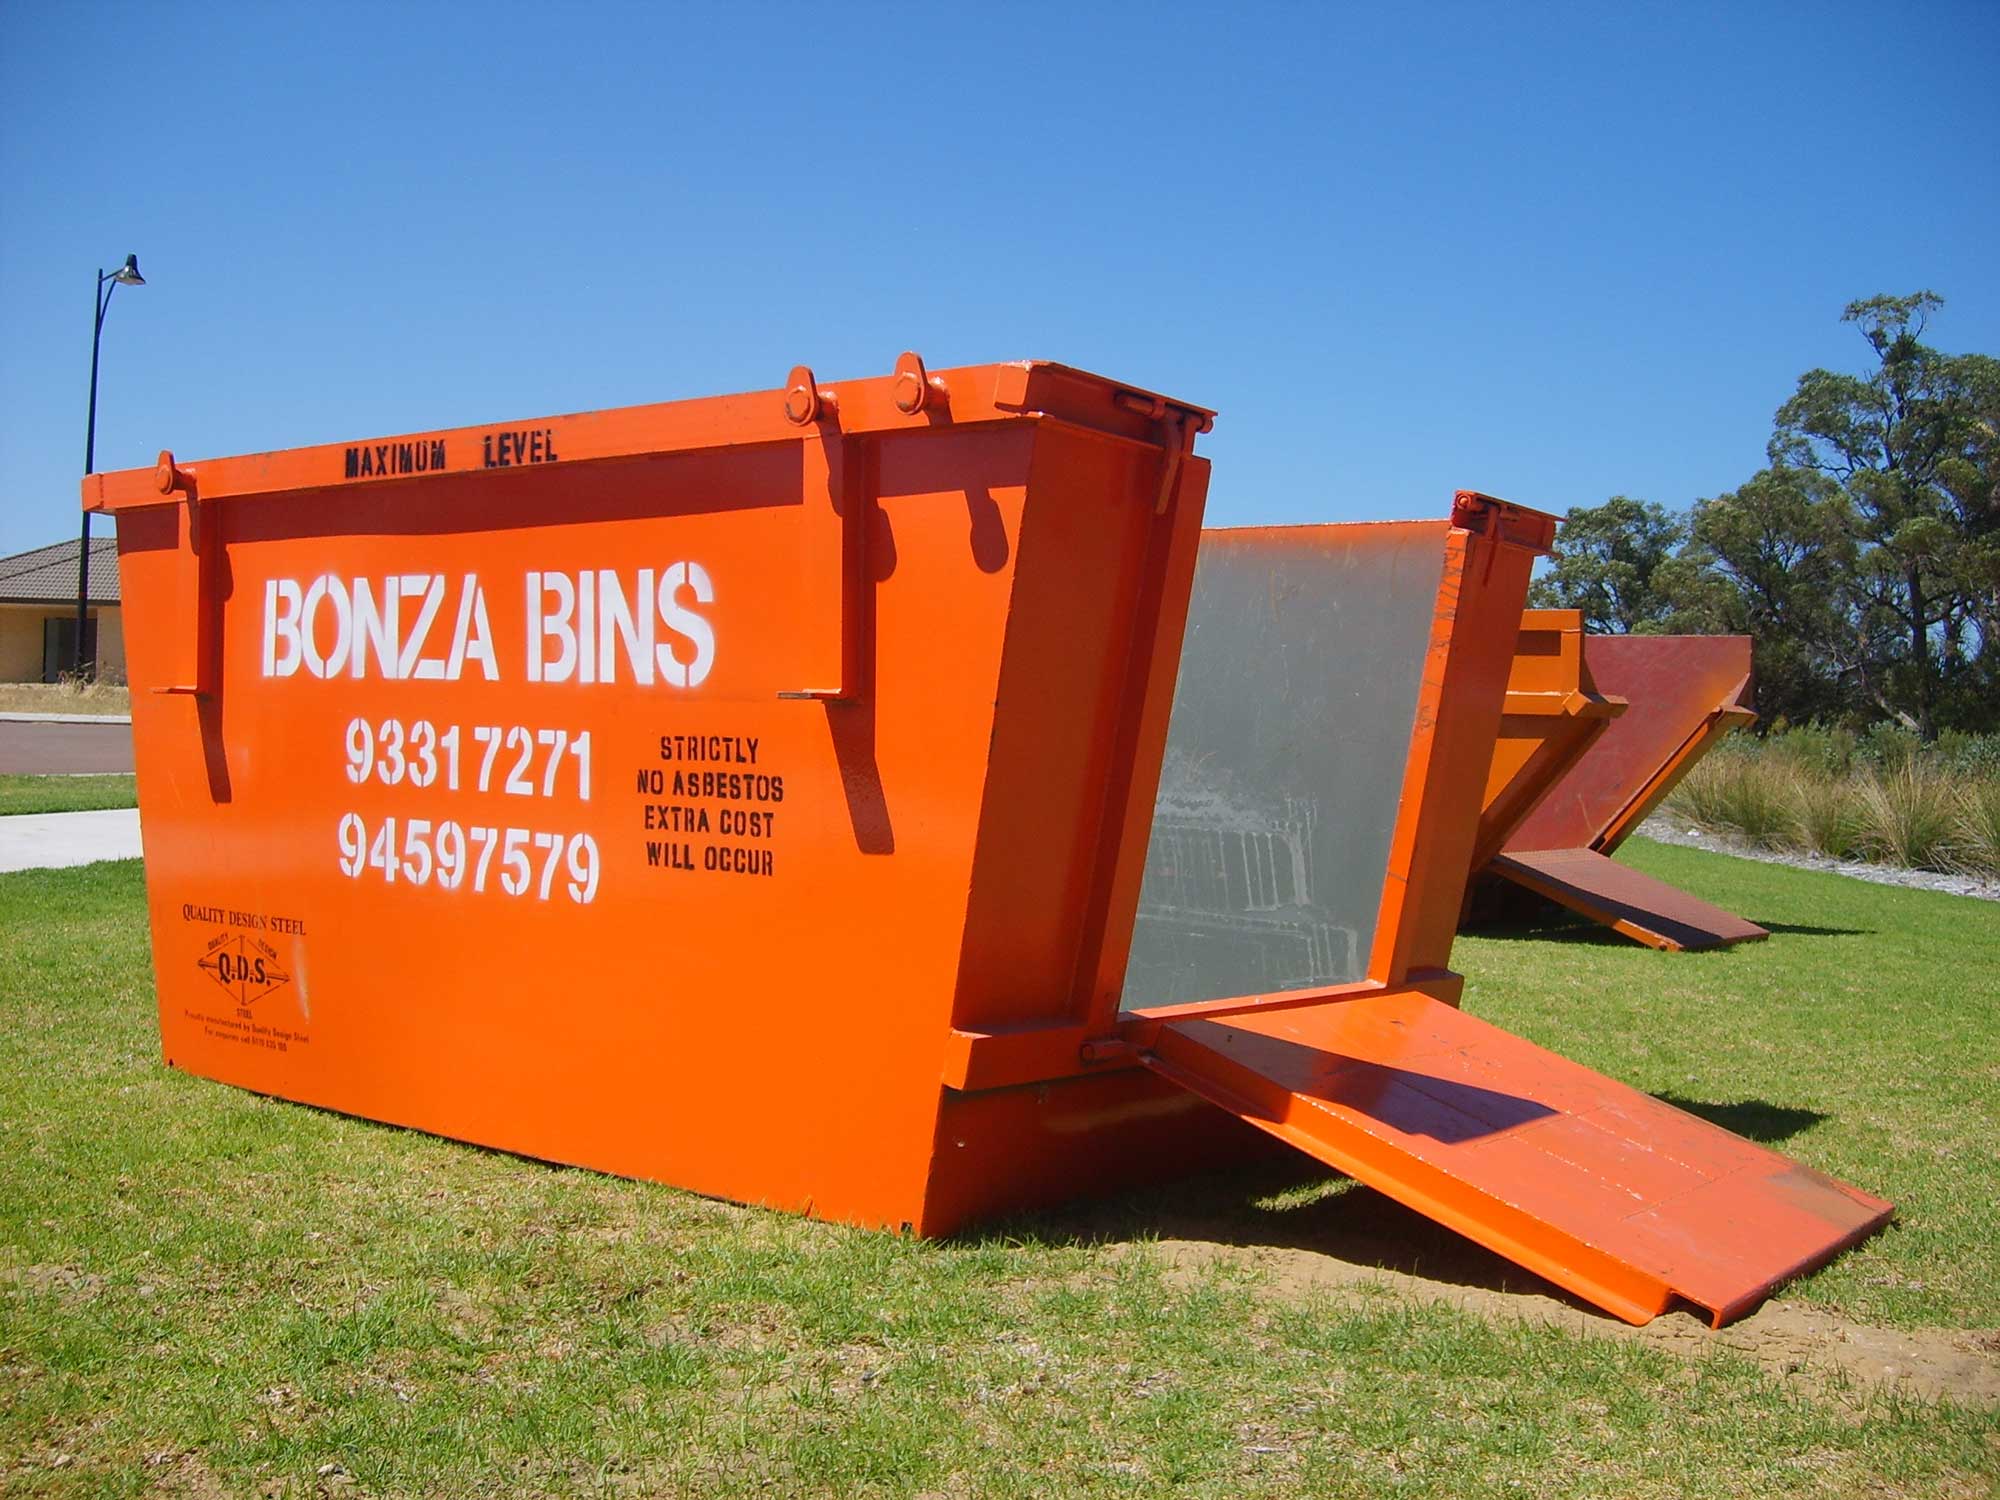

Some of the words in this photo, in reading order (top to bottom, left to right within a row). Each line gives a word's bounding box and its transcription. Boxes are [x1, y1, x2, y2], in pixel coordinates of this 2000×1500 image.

[345, 438, 446, 479] MAXIMUM
[484, 428, 558, 468] LEVEL
[263, 574, 499, 681] BONZA
[526, 561, 716, 688] BINS
[346, 718, 460, 790] 9331
[474, 726, 590, 801] 7271
[660, 736, 758, 764] STRICTLY
[637, 769, 663, 795] NO
[672, 770, 783, 802] ASBESTOS
[645, 805, 710, 833] EXTRA
[720, 809, 774, 838] COST
[338, 812, 600, 904] 94597579
[646, 841, 695, 870] WILL
[704, 846, 773, 876] OCCUR
[183, 903, 225, 924] QUALITY
[229, 911, 267, 929] DESIGN
[271, 917, 306, 936] STEEL
